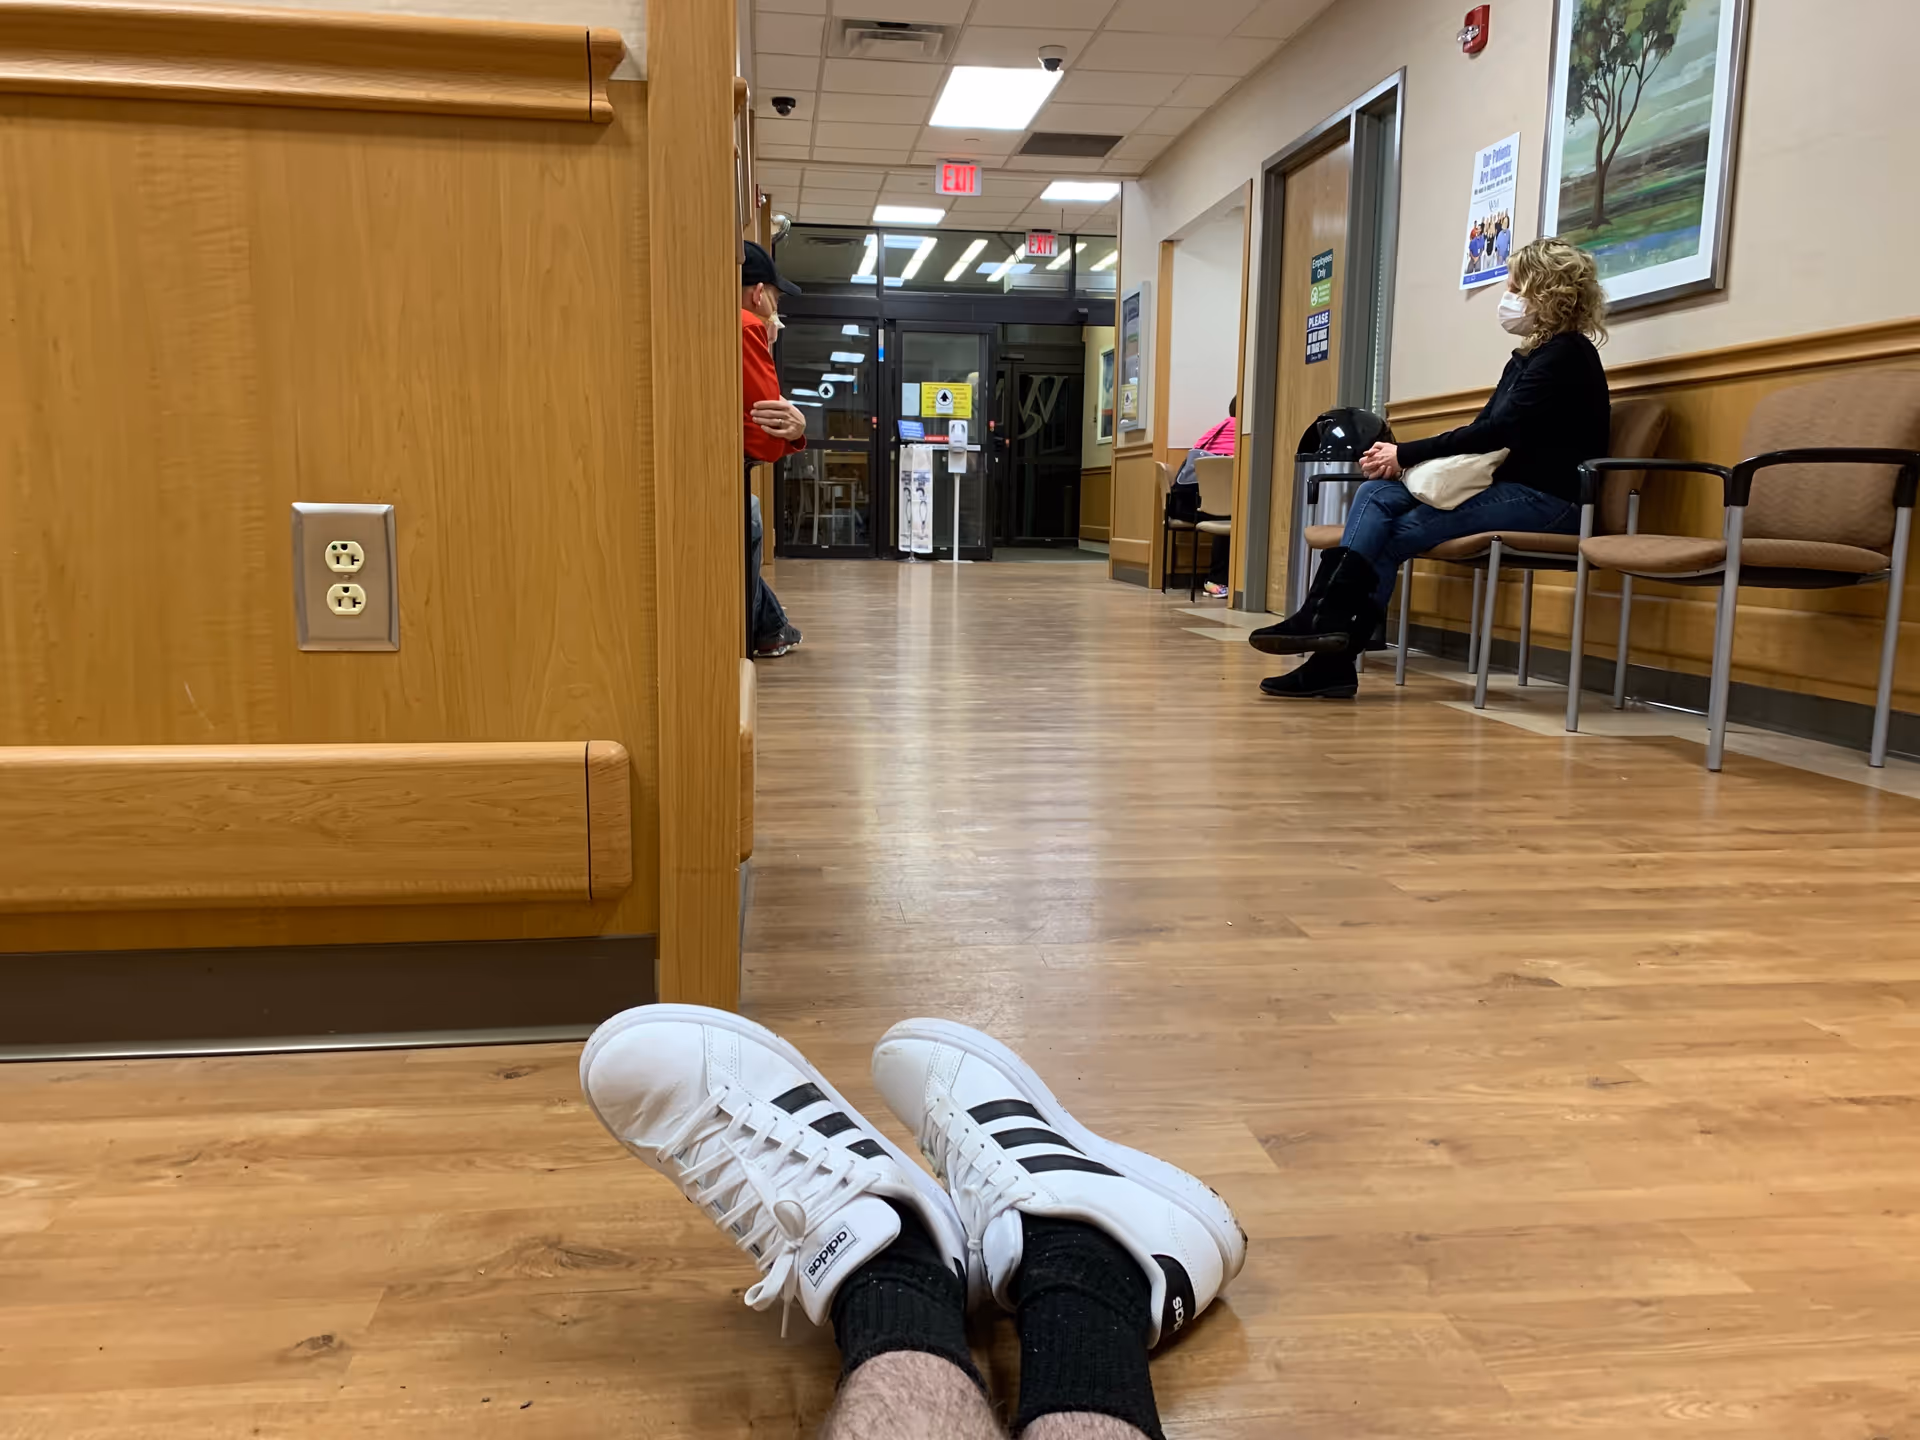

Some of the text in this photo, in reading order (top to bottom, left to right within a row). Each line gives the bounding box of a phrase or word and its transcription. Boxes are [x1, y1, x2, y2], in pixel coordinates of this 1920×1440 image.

[942, 164, 977, 193] EXIT
[1028, 234, 1055, 255] EXIT
[1312, 253, 1333, 269] Employees
[1317, 267, 1326, 278] Only
[1308, 311, 1329, 328] PLEASE
[808, 1231, 847, 1276] adidas
